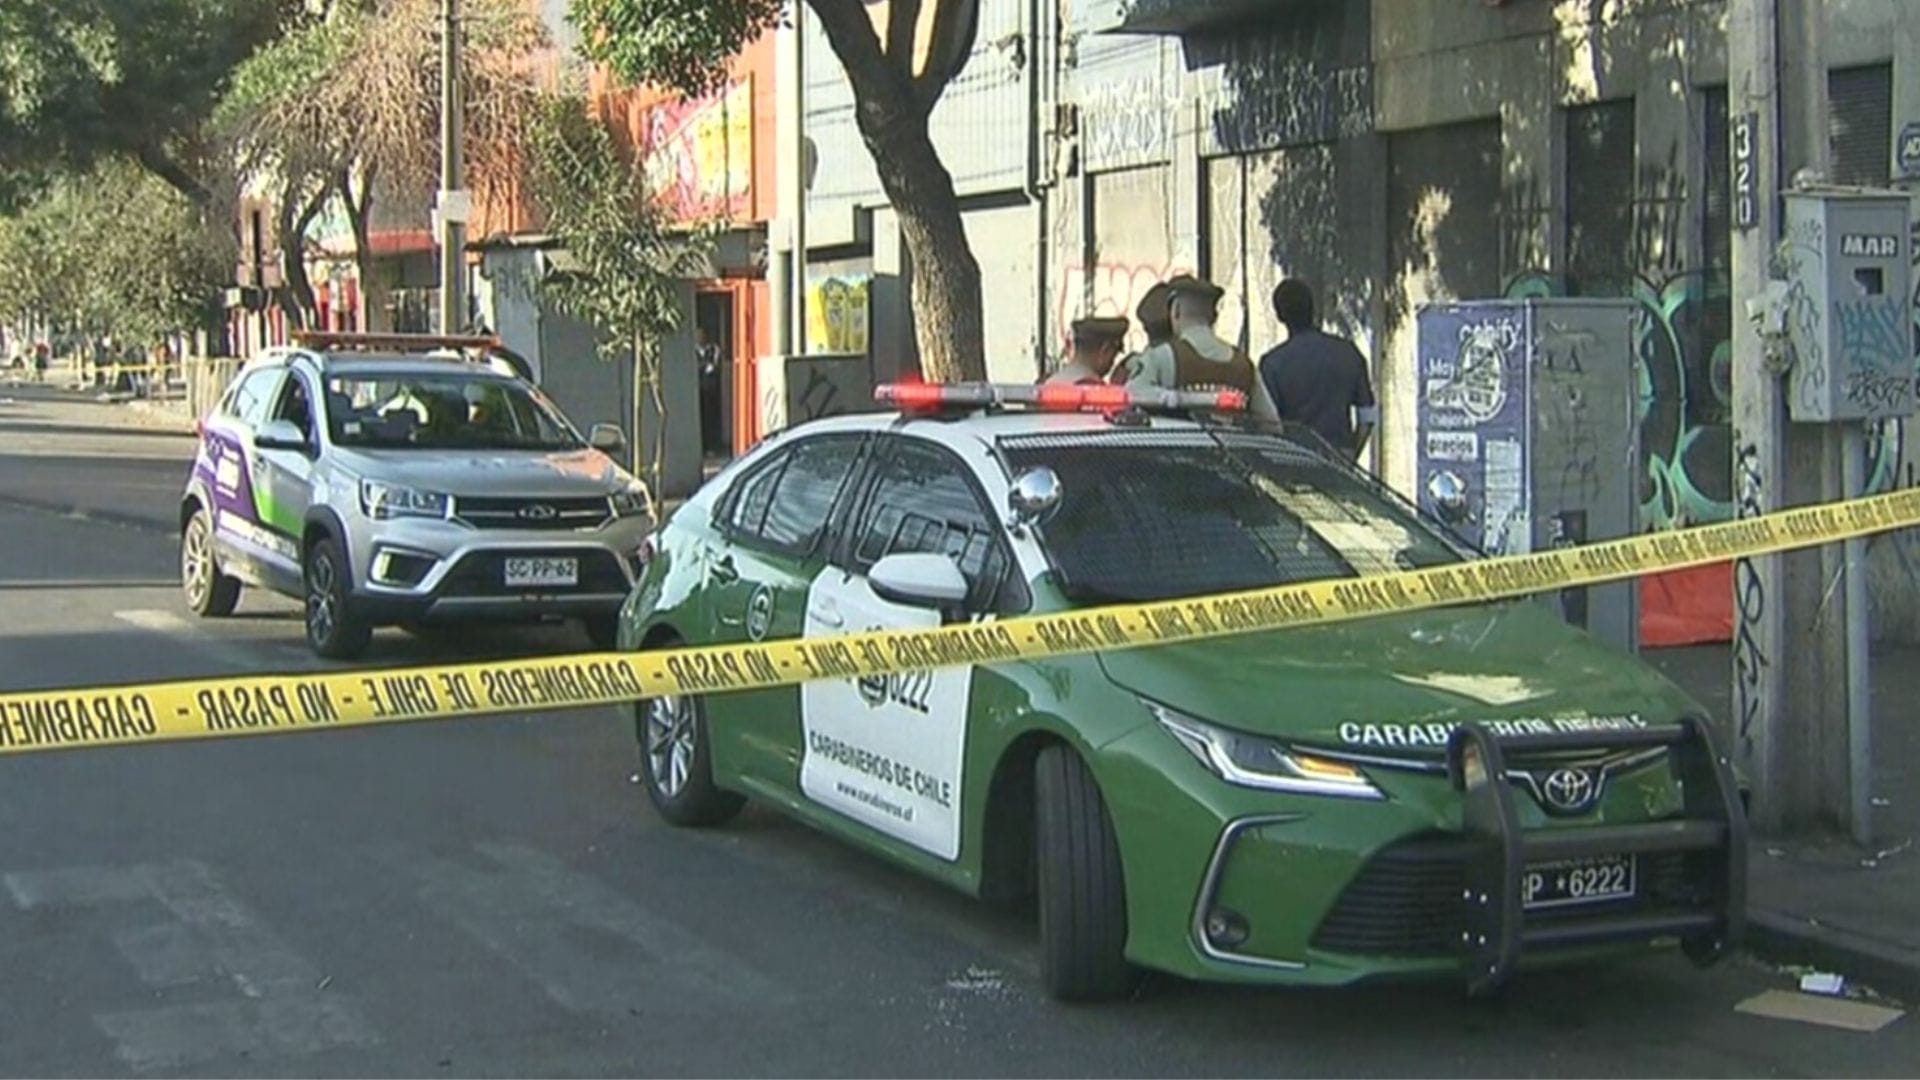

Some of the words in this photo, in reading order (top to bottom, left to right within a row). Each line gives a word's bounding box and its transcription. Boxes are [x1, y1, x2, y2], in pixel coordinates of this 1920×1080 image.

[1736, 123, 1752, 225] 320
[1842, 234, 1897, 256] MAR
[809, 730, 893, 784] CARABINEROS
[894, 763, 913, 791] DE
[914, 770, 951, 808] CHILE
[1569, 864, 1625, 897] 6222
